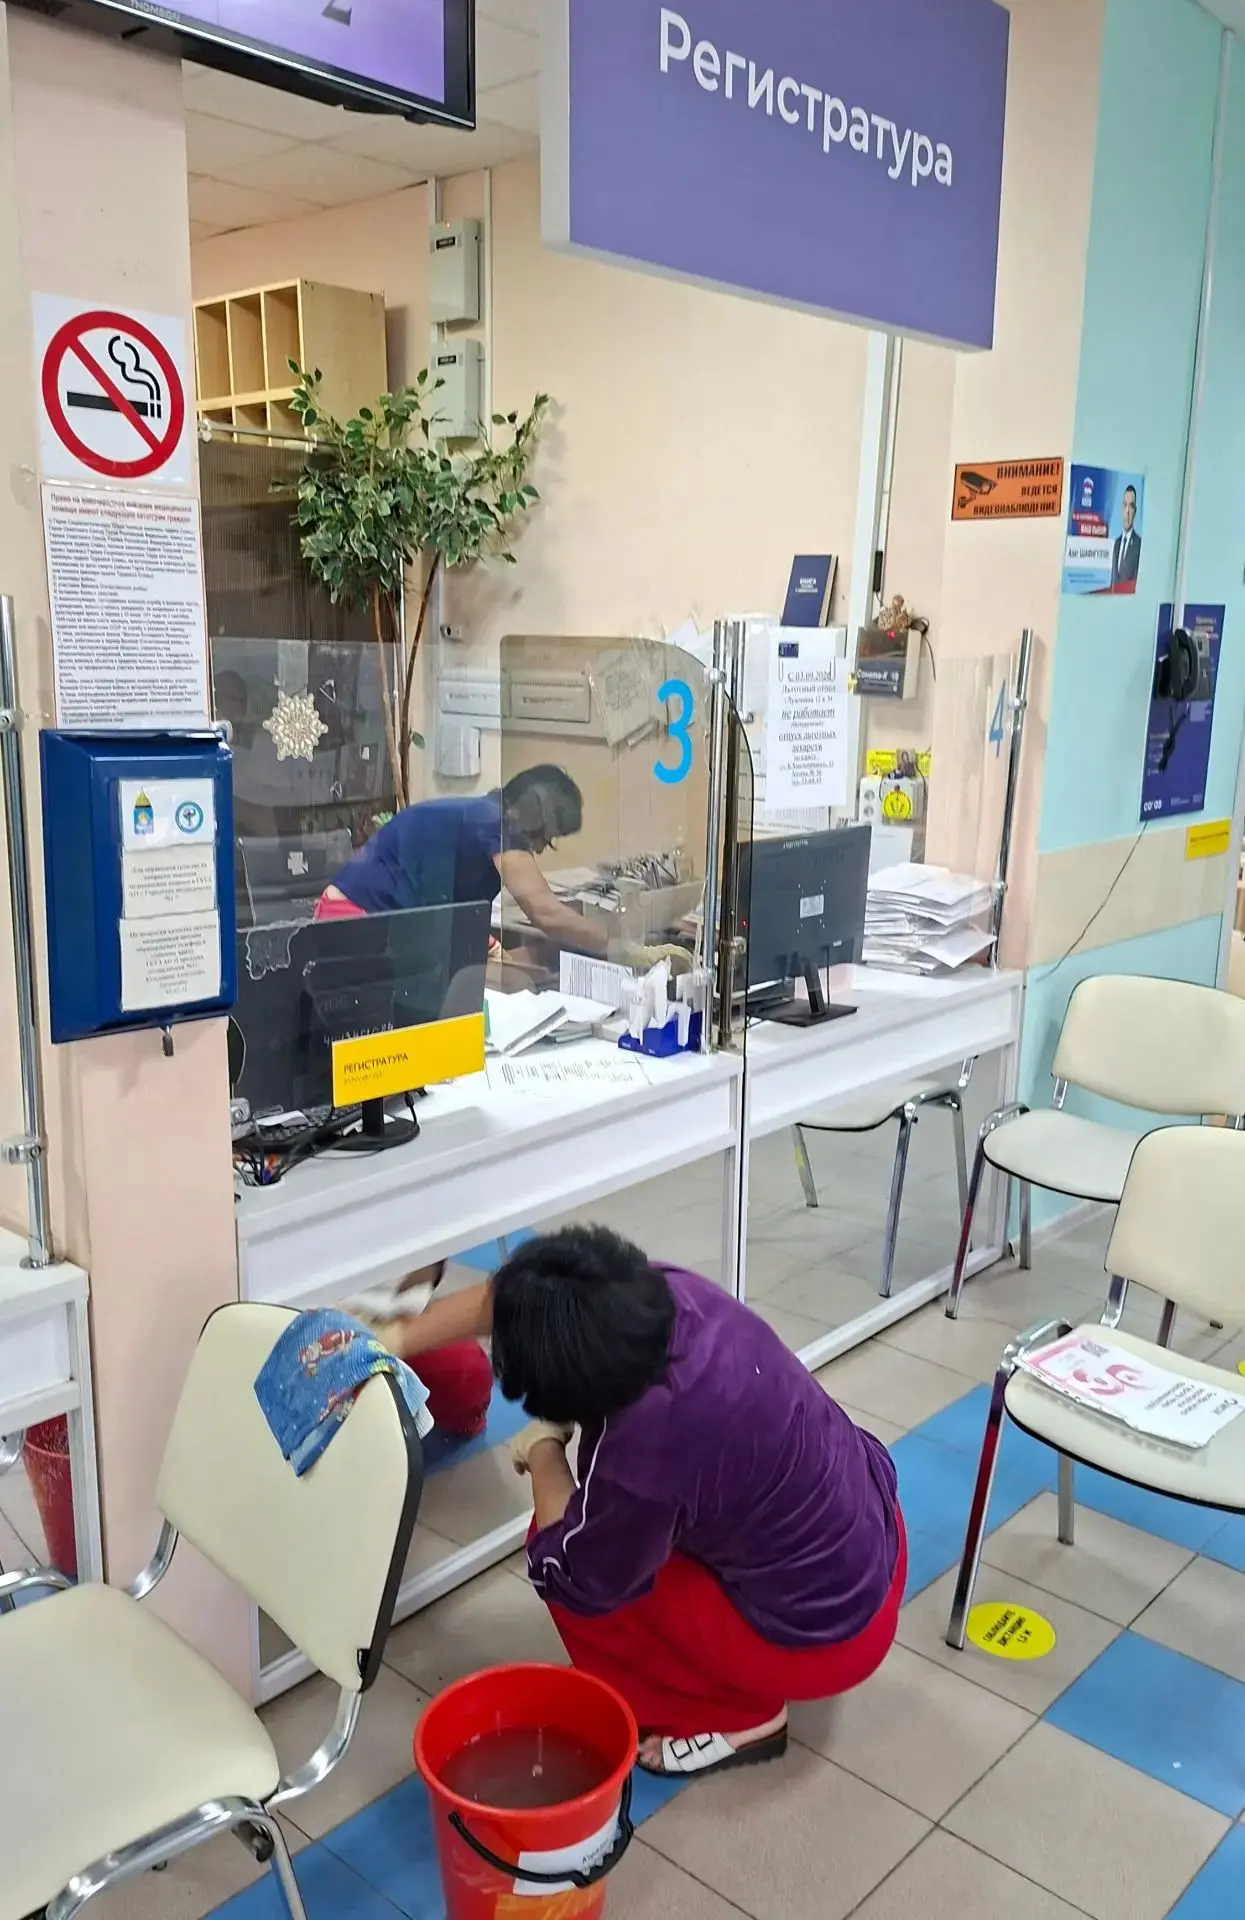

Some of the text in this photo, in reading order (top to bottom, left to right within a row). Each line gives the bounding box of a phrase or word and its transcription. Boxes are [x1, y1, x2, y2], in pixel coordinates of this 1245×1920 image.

[659, 6, 953, 187] Регистратура
[996, 463, 1060, 479] ВНИМАНИЕ!
[1020, 484, 1058, 497] ВЕДЕТСЯ
[973, 501, 1056, 516] ВИДЕОНАБЛЮДЕНИЕ
[988, 679, 1006, 759] 4
[653, 678, 696, 786] 3
[343, 1052, 408, 1074] РЕГИСТРАТУРА
